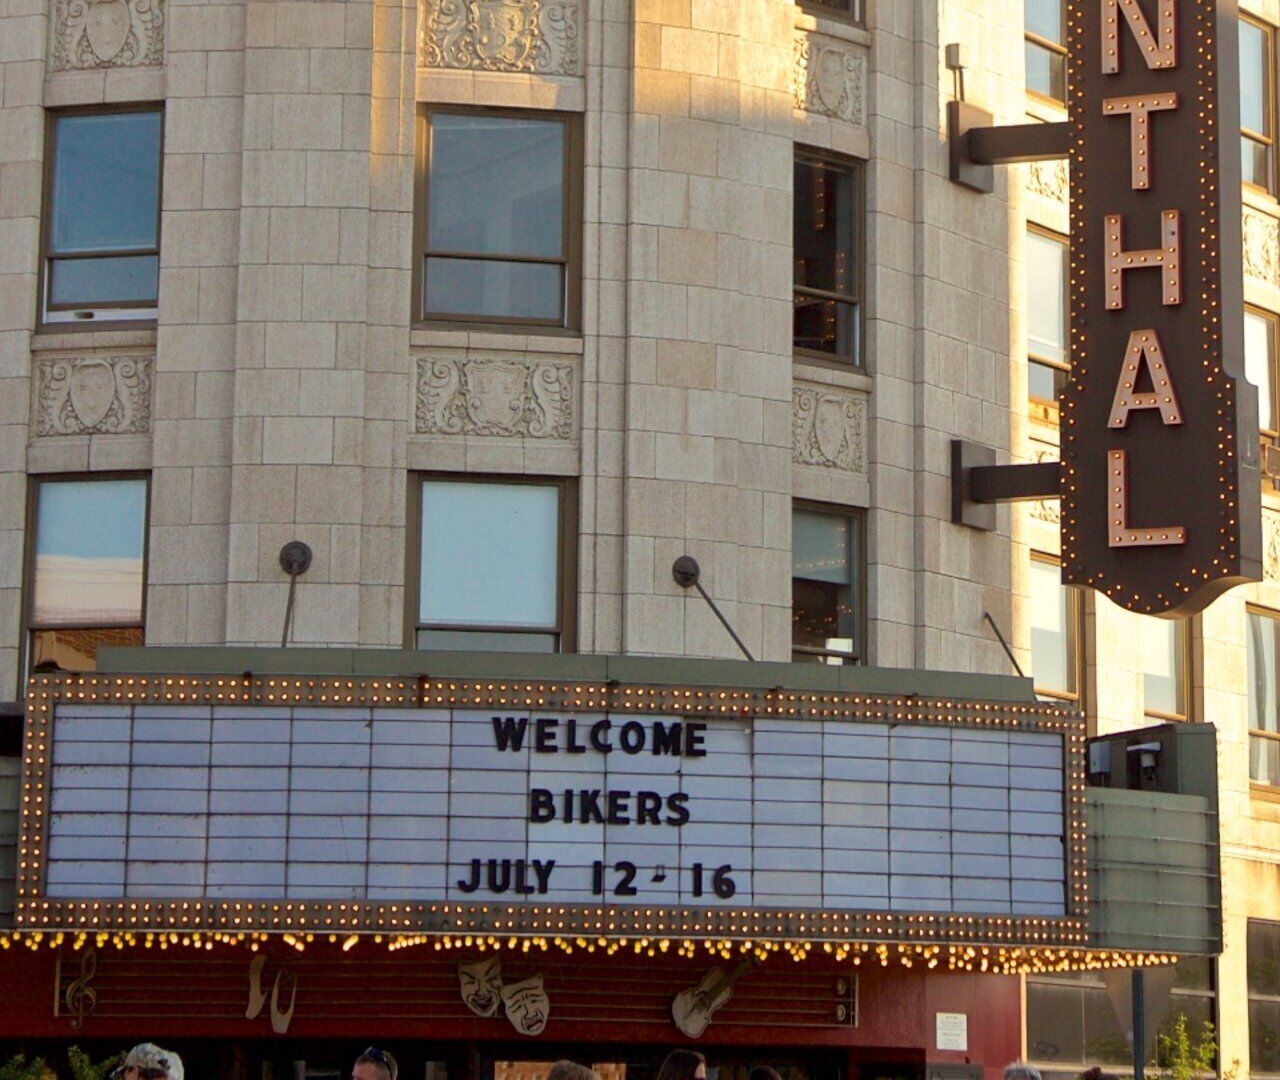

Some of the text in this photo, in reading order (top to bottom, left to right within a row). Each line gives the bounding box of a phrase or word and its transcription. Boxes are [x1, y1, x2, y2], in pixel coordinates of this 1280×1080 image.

[492, 717, 707, 757] WELCOME
[530, 788, 690, 826] BIKERS
[457, 858, 556, 895] JULY
